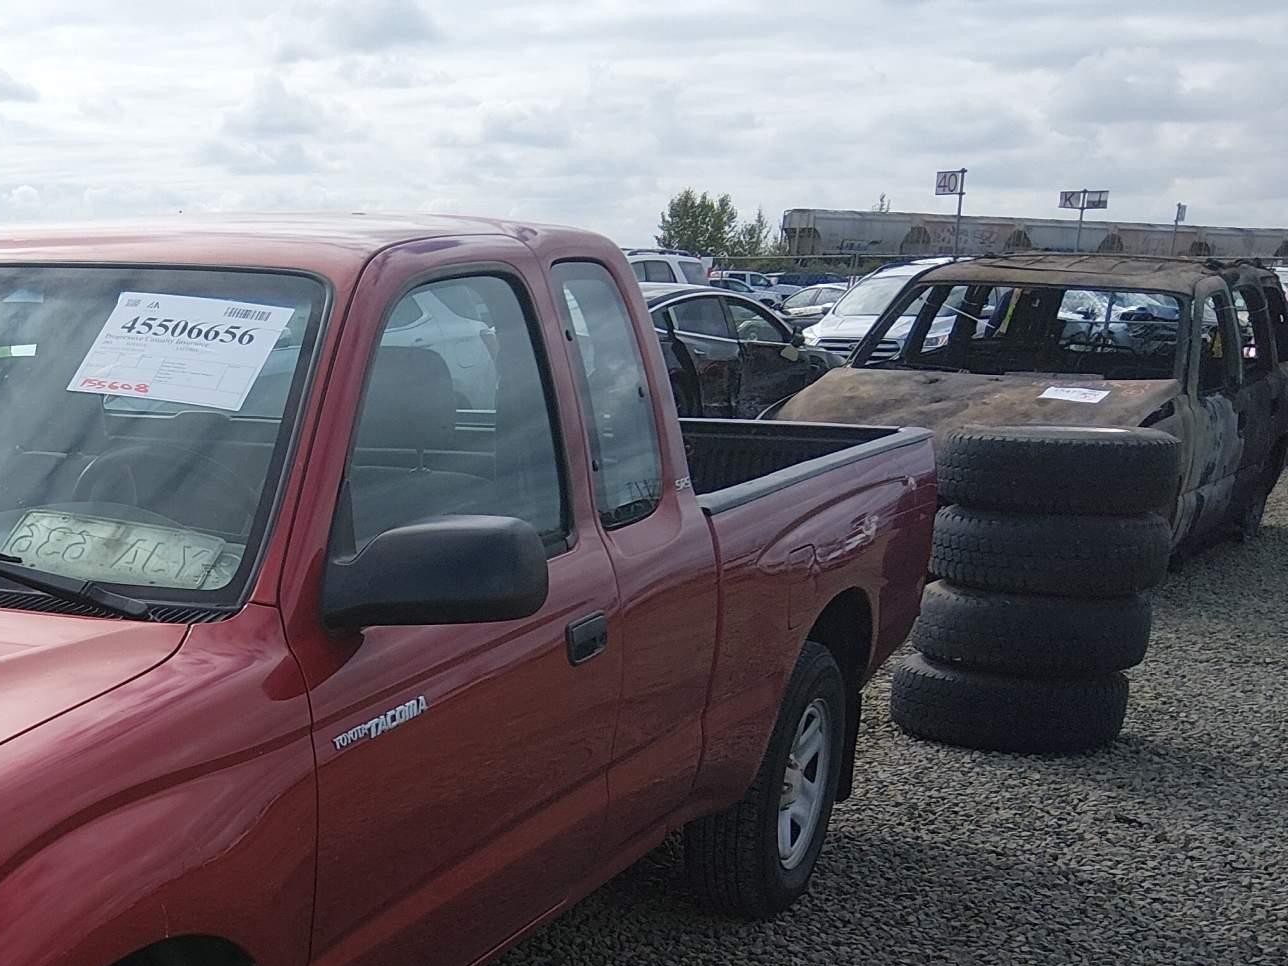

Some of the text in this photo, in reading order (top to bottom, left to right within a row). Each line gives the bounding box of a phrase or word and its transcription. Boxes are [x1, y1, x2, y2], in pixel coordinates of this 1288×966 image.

[937, 173, 958, 193] 40
[1063, 192, 1074, 207] K
[121, 314, 262, 347] 45506656
[80, 379, 150, 393] 155608
[332, 695, 428, 750] TOYOTA TACOMA
